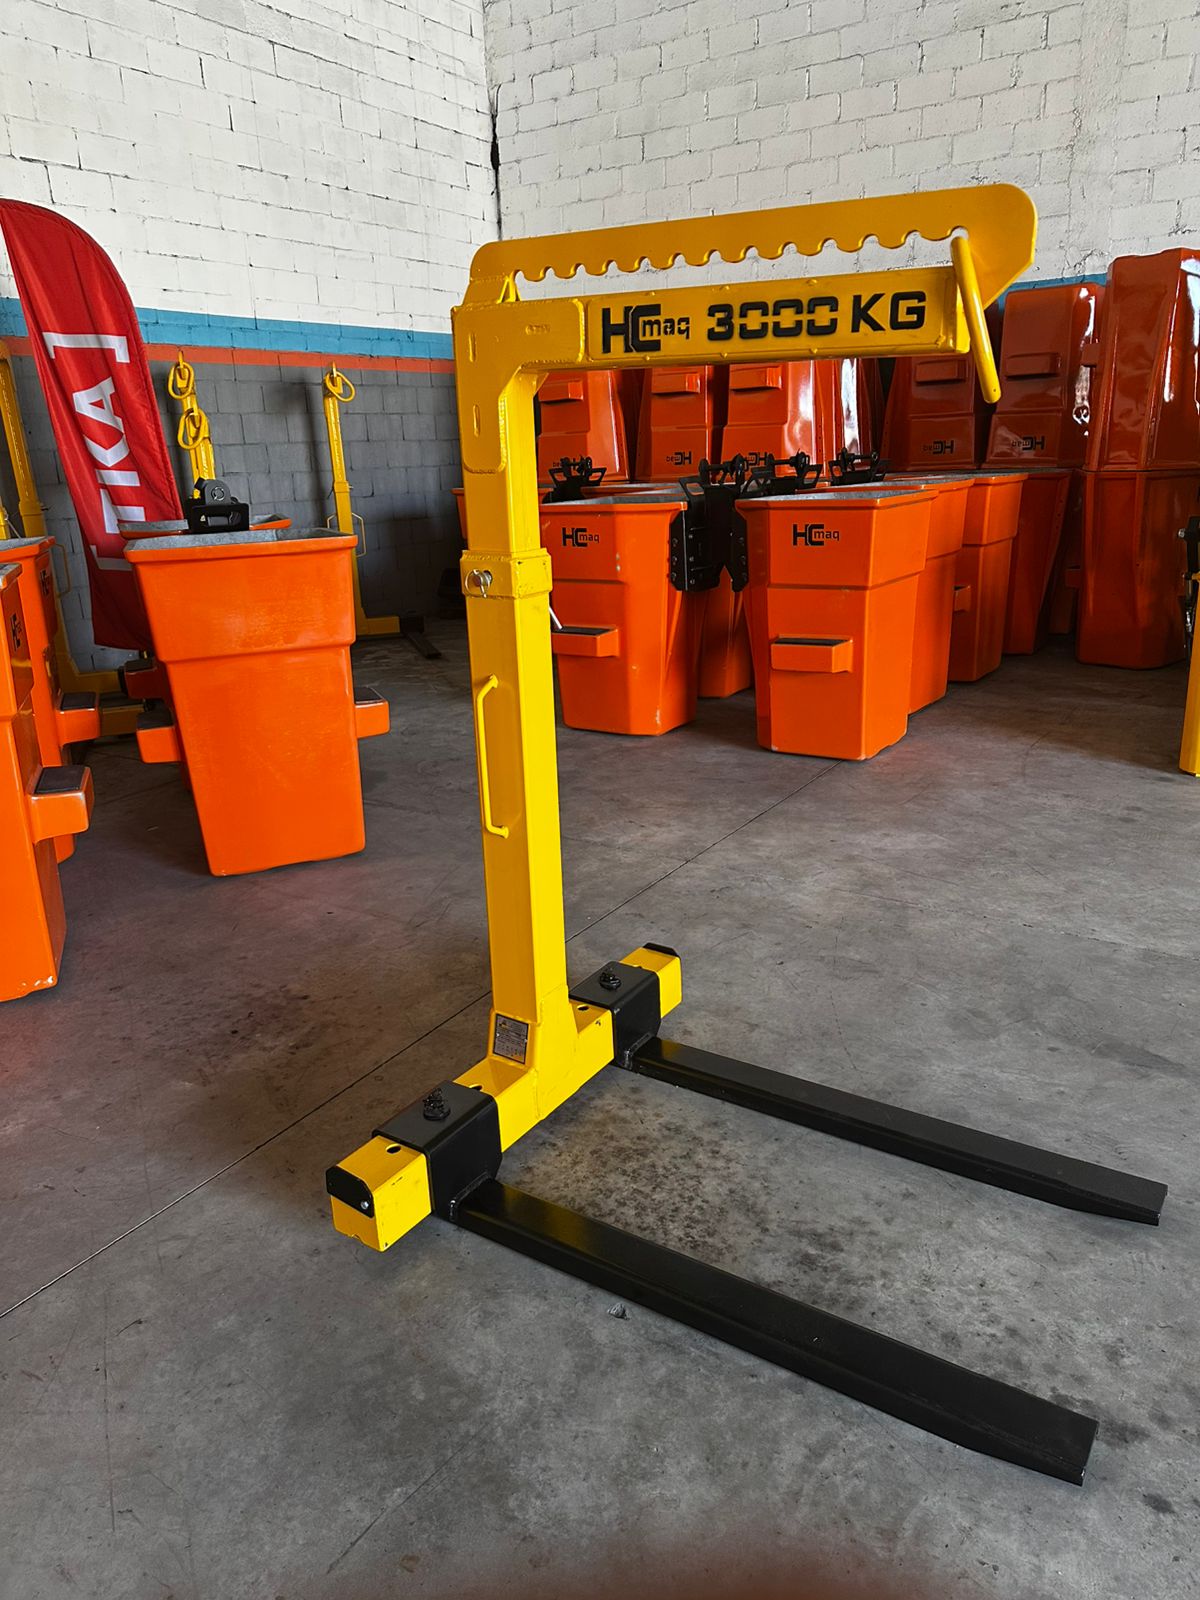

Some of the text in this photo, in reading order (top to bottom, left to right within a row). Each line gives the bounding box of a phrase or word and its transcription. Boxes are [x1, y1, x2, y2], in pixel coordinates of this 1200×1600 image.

[707, 296, 838, 341] 3000
[851, 290, 927, 333] KG
[792, 524, 840, 546] HCmaq
